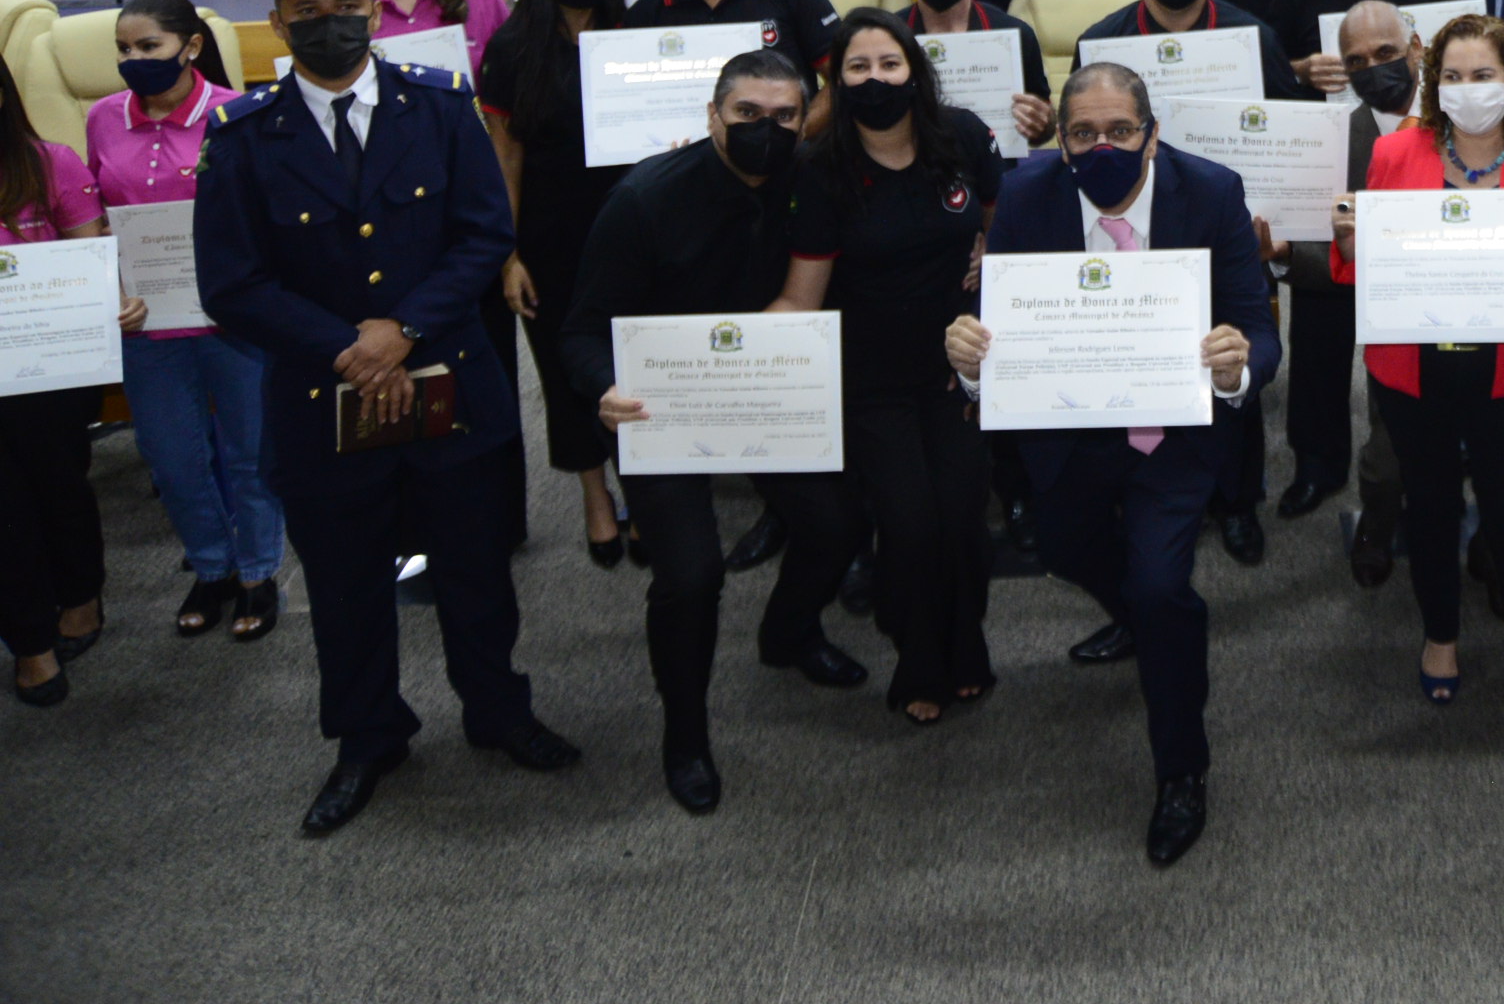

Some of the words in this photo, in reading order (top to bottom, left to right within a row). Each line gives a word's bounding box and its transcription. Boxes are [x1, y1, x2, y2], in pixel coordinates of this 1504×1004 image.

[1184, 133, 1223, 145] Diploma
[1227, 135, 1237, 145] de
[1241, 135, 1271, 146] Honra
[1274, 136, 1285, 147] ao
[0, 279, 26, 292] onra
[1011, 296, 1058, 310] Diploma
[1063, 296, 1075, 308] de
[1080, 295, 1117, 308] Honra
[1121, 294, 1134, 307] ao
[644, 357, 691, 370] Diploma
[695, 357, 707, 369] de
[712, 356, 749, 368] Honra
[752, 355, 765, 367] ao
